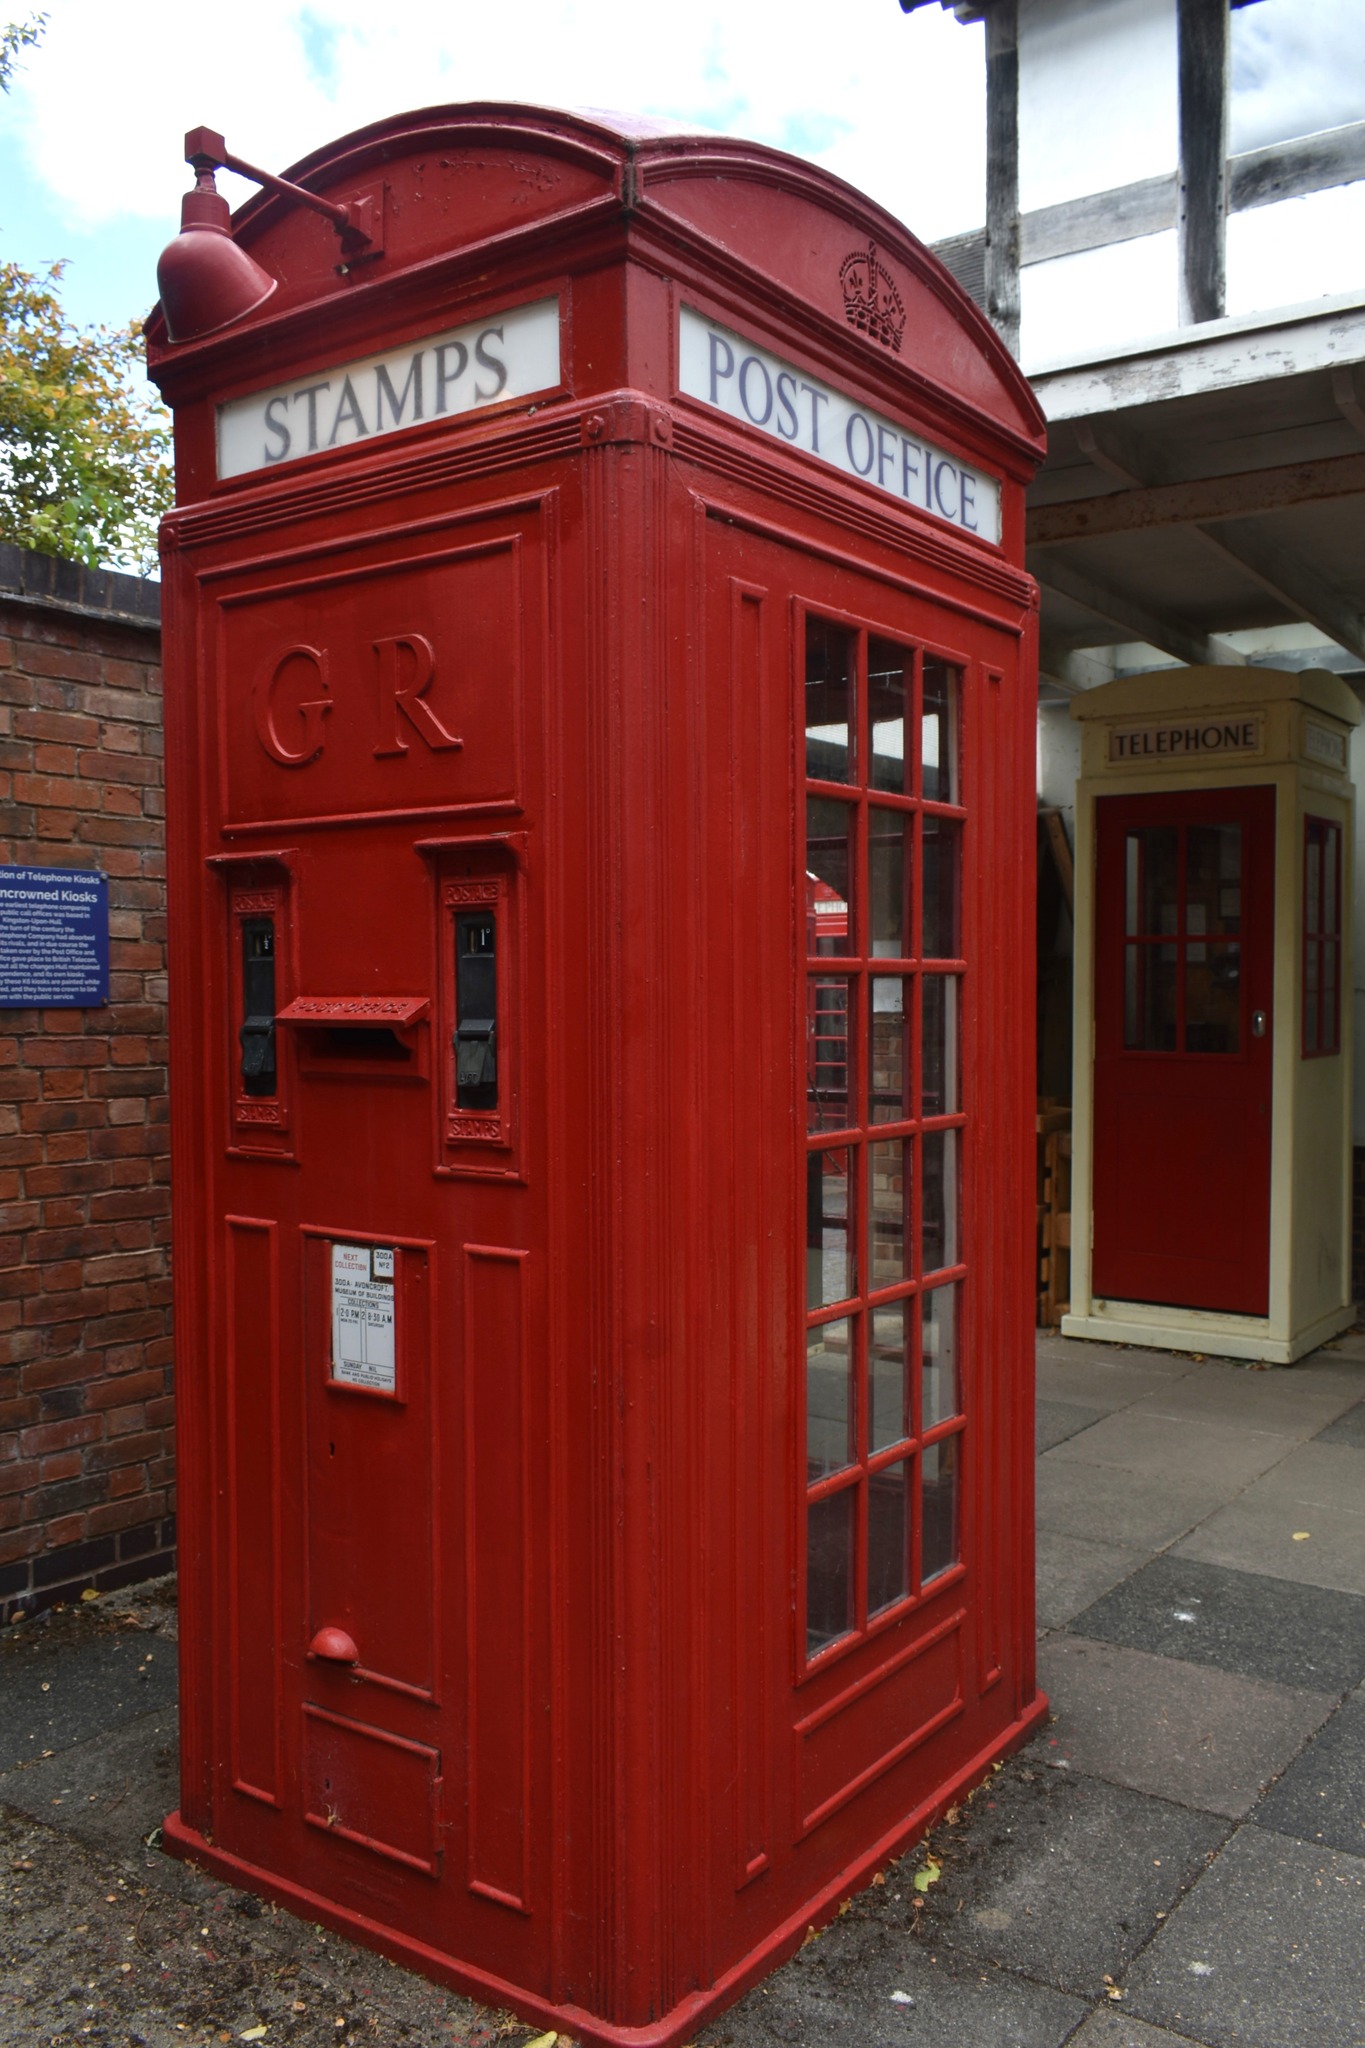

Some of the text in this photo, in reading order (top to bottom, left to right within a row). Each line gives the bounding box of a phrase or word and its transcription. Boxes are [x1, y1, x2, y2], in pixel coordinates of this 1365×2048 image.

[264, 325, 508, 463] STAMPS
[707, 331, 978, 532] POST OFFICE
[254, 632, 464, 767] G R
[1115, 723, 1255, 757] TELEPHONE
[16, 871, 26, 880] of
[27, 872, 72, 883] Telephone
[74, 875, 100, 884] Kiosks
[0, 889, 98, 903] ncrowned Kiosks
[446, 884, 498, 902] POSTAGE
[28, 903, 59, 911] telephone
[28, 932, 55, 941] Company
[33, 948, 41, 956] by
[291, 1001, 409, 1014] POST OFFICE
[452, 1119, 499, 1137] STAMPS
[343, 1253, 358, 1261] NEXT
[375, 1251, 393, 1260] 300A
[335, 1261, 367, 1271] COLLECTION
[335, 1287, 357, 1296] MUSEUM
[348, 1298, 379, 1309] COLLECTIONS
[361, 1311, 366, 1320] 2
[343, 1360, 362, 1370] SUNDAY
[358, 1378, 380, 1387] COLLECTION
